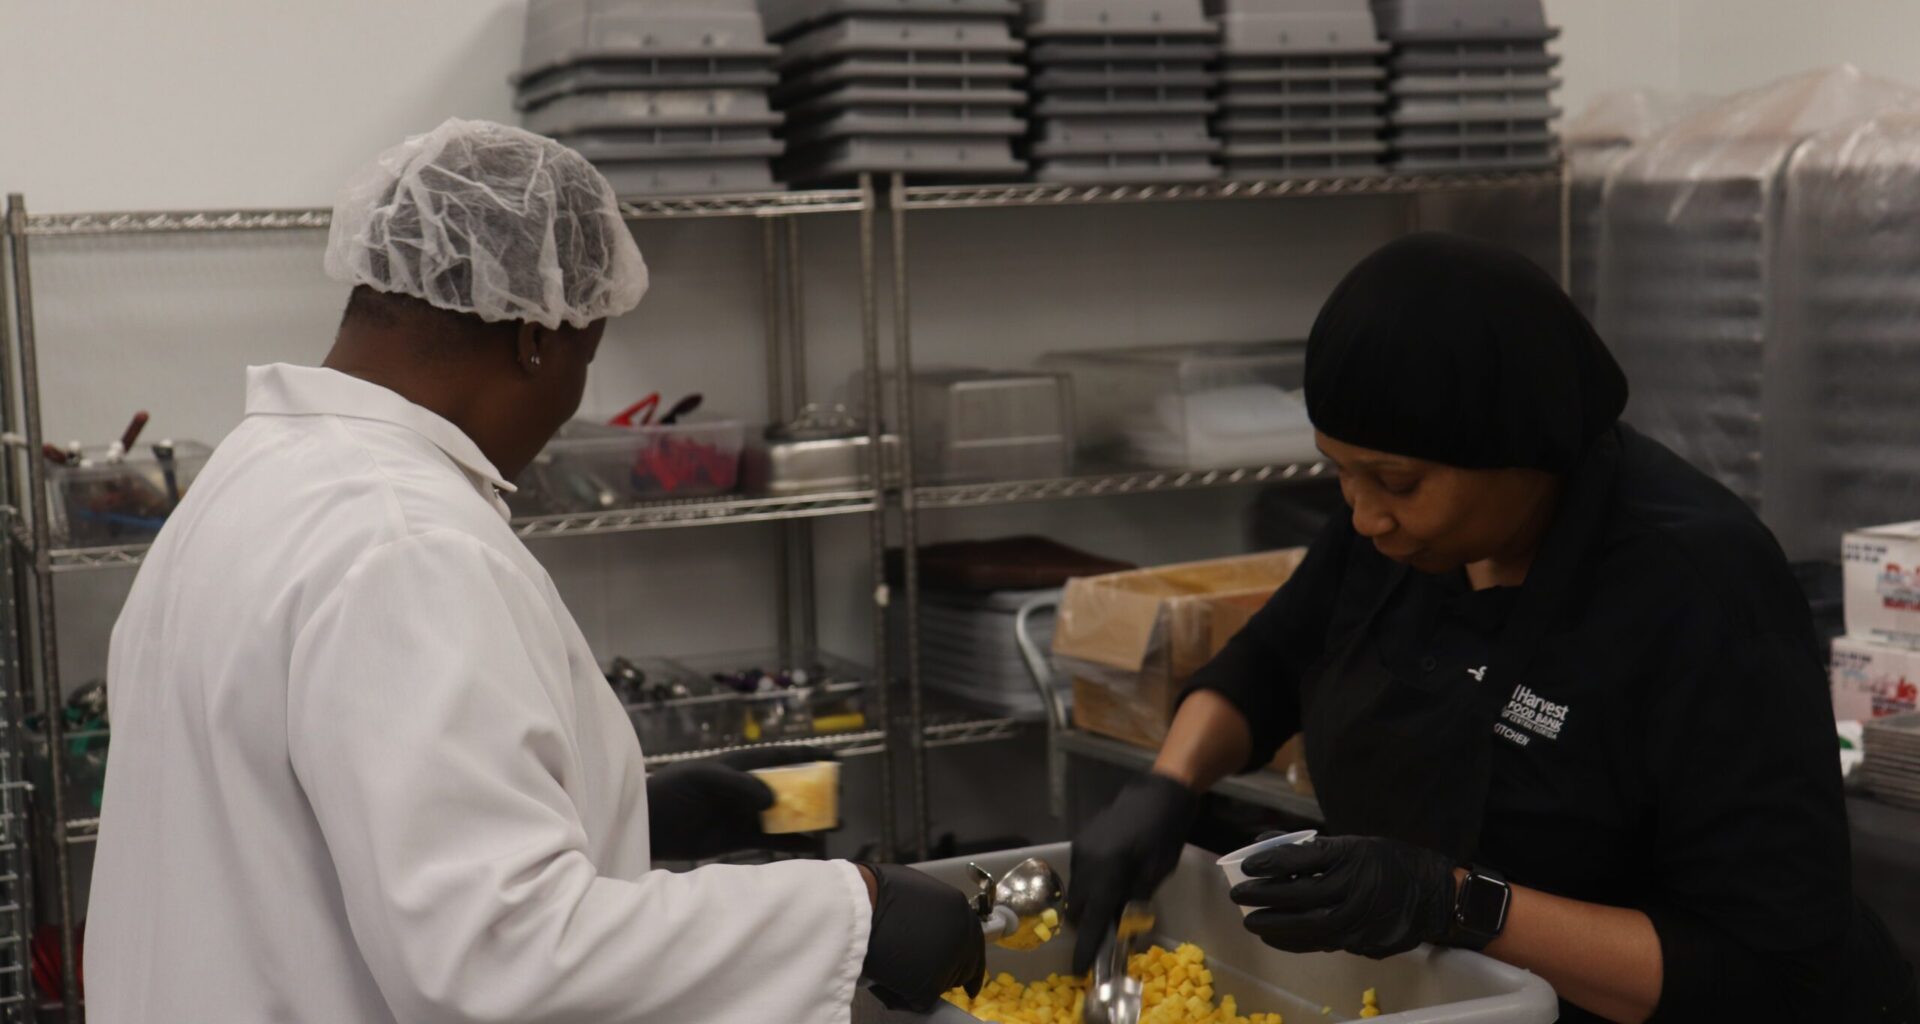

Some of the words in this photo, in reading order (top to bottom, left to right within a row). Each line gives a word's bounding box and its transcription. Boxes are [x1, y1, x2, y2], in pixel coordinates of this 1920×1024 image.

[1508, 700, 1536, 719] FOOD
[1534, 712, 1563, 731] BANK
[1516, 686, 1569, 721] Harvest
